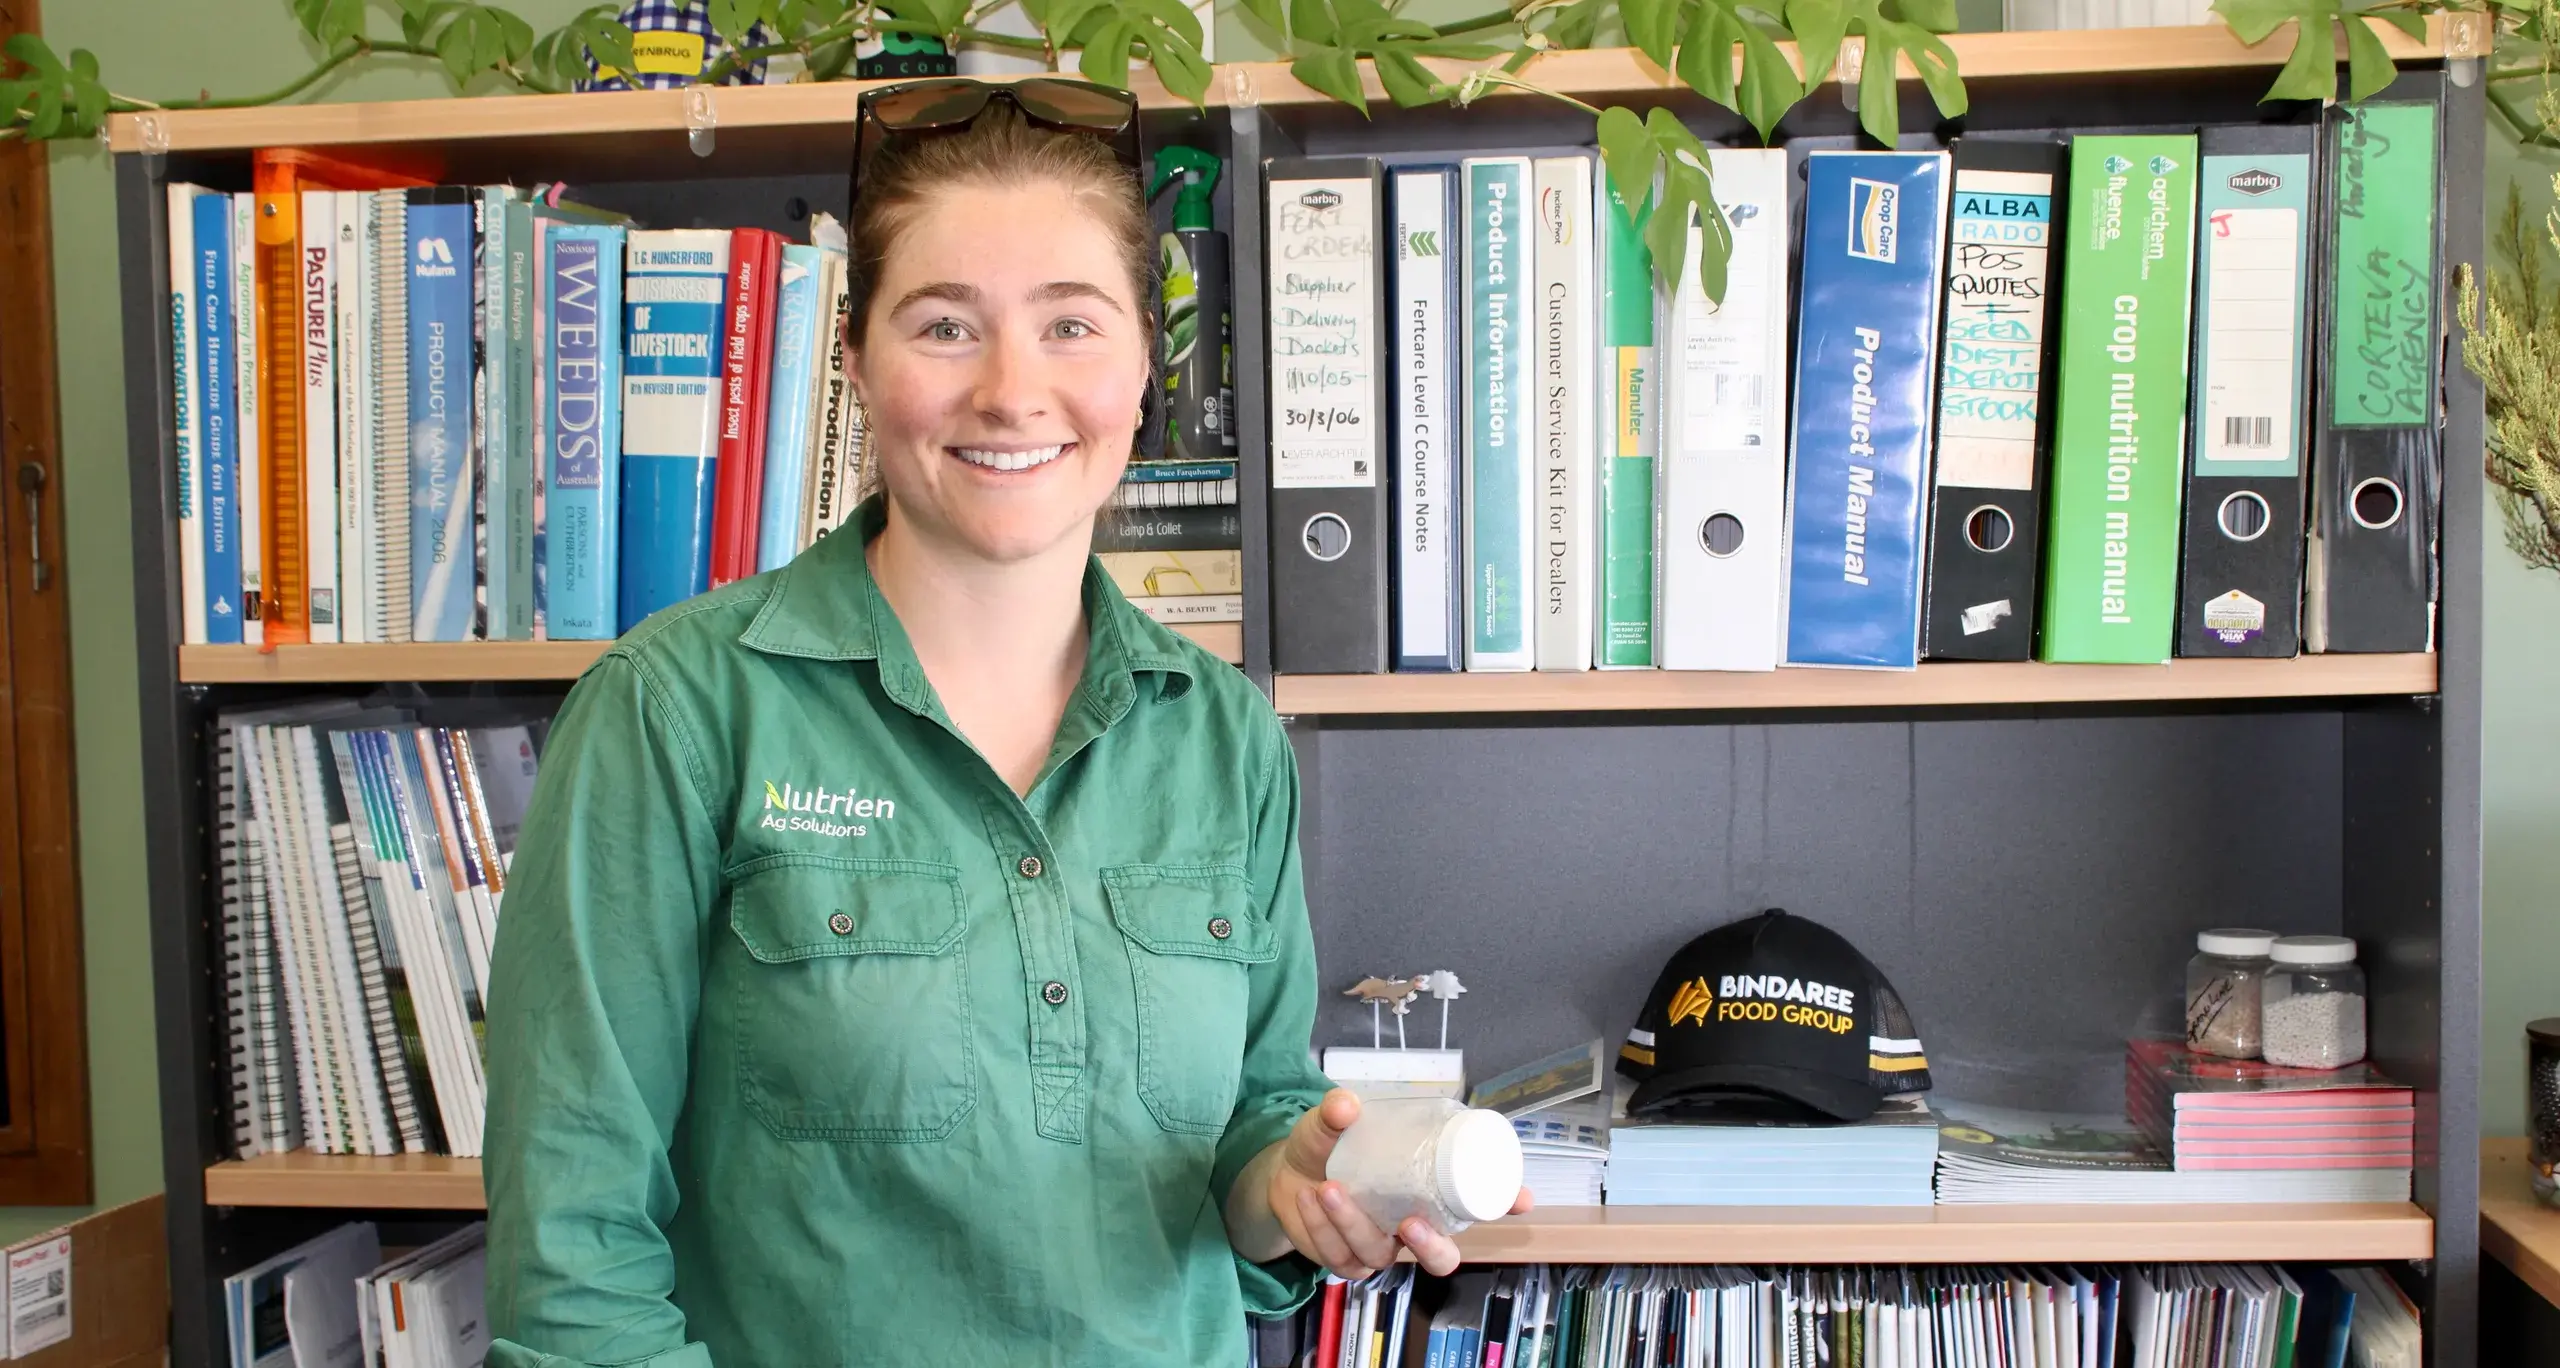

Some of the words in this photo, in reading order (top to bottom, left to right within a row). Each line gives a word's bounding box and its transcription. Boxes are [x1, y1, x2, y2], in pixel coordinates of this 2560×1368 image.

[2231, 175, 2279, 188] marbig
[1302, 194, 1339, 205] marbig
[1554, 189, 1562, 220] Incitec
[1877, 187, 1895, 223] Crop
[1963, 198, 2040, 218] ALBA
[2107, 175, 2128, 240] fluence
[486, 203, 502, 257] CROP
[1487, 182, 1508, 285] Product
[1554, 221, 1562, 245] Pivot
[1961, 222, 2042, 242] RADO
[2148, 178, 2170, 259] agrichem
[2209, 213, 2233, 238] J
[556, 242, 596, 254] Noxious
[1879, 226, 1893, 258] Care
[1957, 244, 2024, 271] POS
[416, 263, 456, 277] Nufarm
[512, 251, 525, 284] Plant
[650, 250, 713, 266] HUNGERFORD
[737, 260, 751, 290] colour
[1278, 273, 1356, 302] Supplier
[1950, 273, 2041, 300] QUOTES
[238, 262, 253, 338] Agronomy
[487, 264, 502, 331] WEEDS
[736, 292, 749, 302] in
[511, 287, 525, 341] Analysis
[634, 306, 653, 331] OF
[734, 304, 750, 334] crops
[1275, 306, 1356, 339] Delivery
[1949, 317, 2032, 341] SEED
[629, 333, 709, 358] LIVESTOCK
[1414, 299, 1428, 369] Fertcare
[1548, 282, 1567, 379] Customer
[2357, 245, 2396, 418] CORTEVA
[2394, 258, 2430, 416] AGENCY
[170, 291, 191, 432] CONSERVATION
[241, 343, 254, 357] in
[557, 256, 597, 459] WEEDS
[728, 335, 745, 360] field
[427, 321, 446, 421] PRODUCT
[728, 362, 743, 374] of
[1488, 293, 1509, 447] Information
[1943, 365, 2040, 390] DEPOT
[241, 360, 255, 415] Practice
[728, 377, 744, 405] pests
[1414, 375, 1430, 418] Level
[1628, 367, 1645, 436] Manutec
[1850, 326, 1881, 458] Product
[723, 407, 740, 439] Insect
[1285, 406, 1361, 433] 30/3/06
[1549, 385, 1567, 460] Service
[1942, 394, 2037, 422] STOCK
[1414, 423, 1429, 435] C
[2106, 373, 2140, 501] nutrition
[177, 435, 194, 520] FARMING
[429, 427, 447, 513] MANUAL
[556, 474, 599, 486] Australia
[570, 463, 582, 473] of
[1155, 469, 1175, 477] Bruce
[1176, 468, 1221, 478] Farquharson
[1414, 439, 1430, 498] Course
[1549, 467, 1567, 498] Kit
[577, 505, 588, 560] PARSONS
[1119, 523, 1145, 539] Lamp
[1146, 523, 1154, 536] &
[1156, 522, 1183, 536] Collet
[1415, 503, 1430, 553] Notes
[1549, 504, 1567, 534] for
[1844, 465, 1874, 587] Manual
[430, 517, 447, 565] 2006
[1484, 563, 1493, 587] Upper
[1549, 540, 1567, 615] Dealers
[2101, 512, 2132, 624] manual
[1185, 605, 1217, 614] BEATTIE
[1484, 587, 1493, 614] Murray
[562, 617, 593, 629] Inkata
[764, 780, 895, 819] Nutrien
[761, 813, 786, 832] Ag
[789, 816, 867, 837] Solutions
[1719, 974, 1855, 1014] BINDAREE
[1718, 1002, 1778, 1022] FOOD
[1782, 1004, 1854, 1035] GROUP
